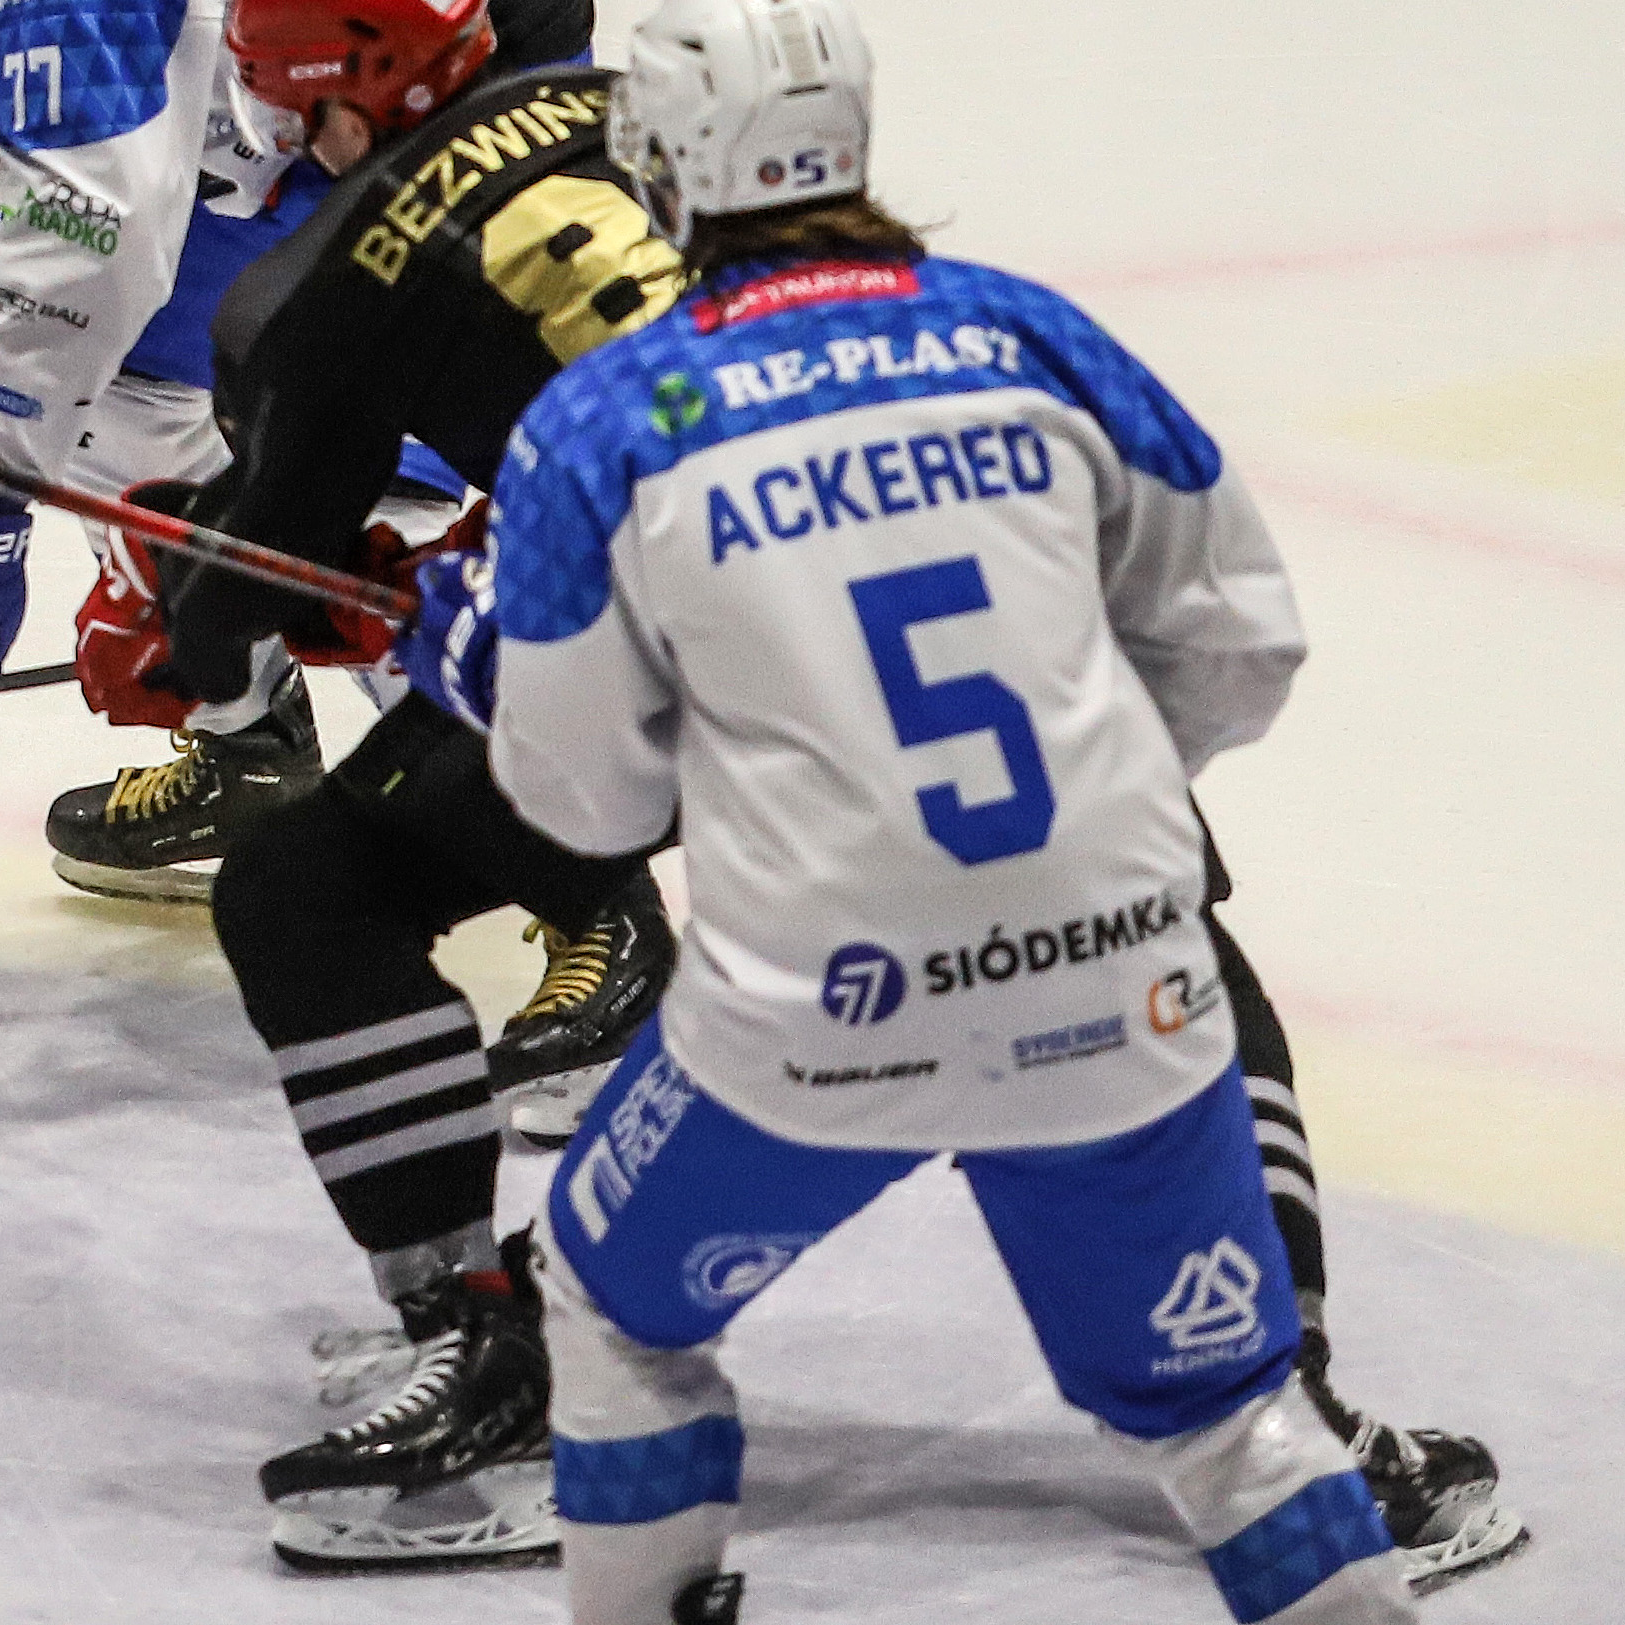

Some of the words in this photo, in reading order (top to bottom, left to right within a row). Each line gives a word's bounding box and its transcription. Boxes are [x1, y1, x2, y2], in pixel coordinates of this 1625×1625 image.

[3, 43, 62, 133] 77
[793, 148, 829, 188] 5
[28, 200, 119, 257] RADKO
[704, 421, 1055, 567] ACKERED
[849, 556, 1057, 866] 5
[925, 890, 1182, 996] SIÓDEMKA
